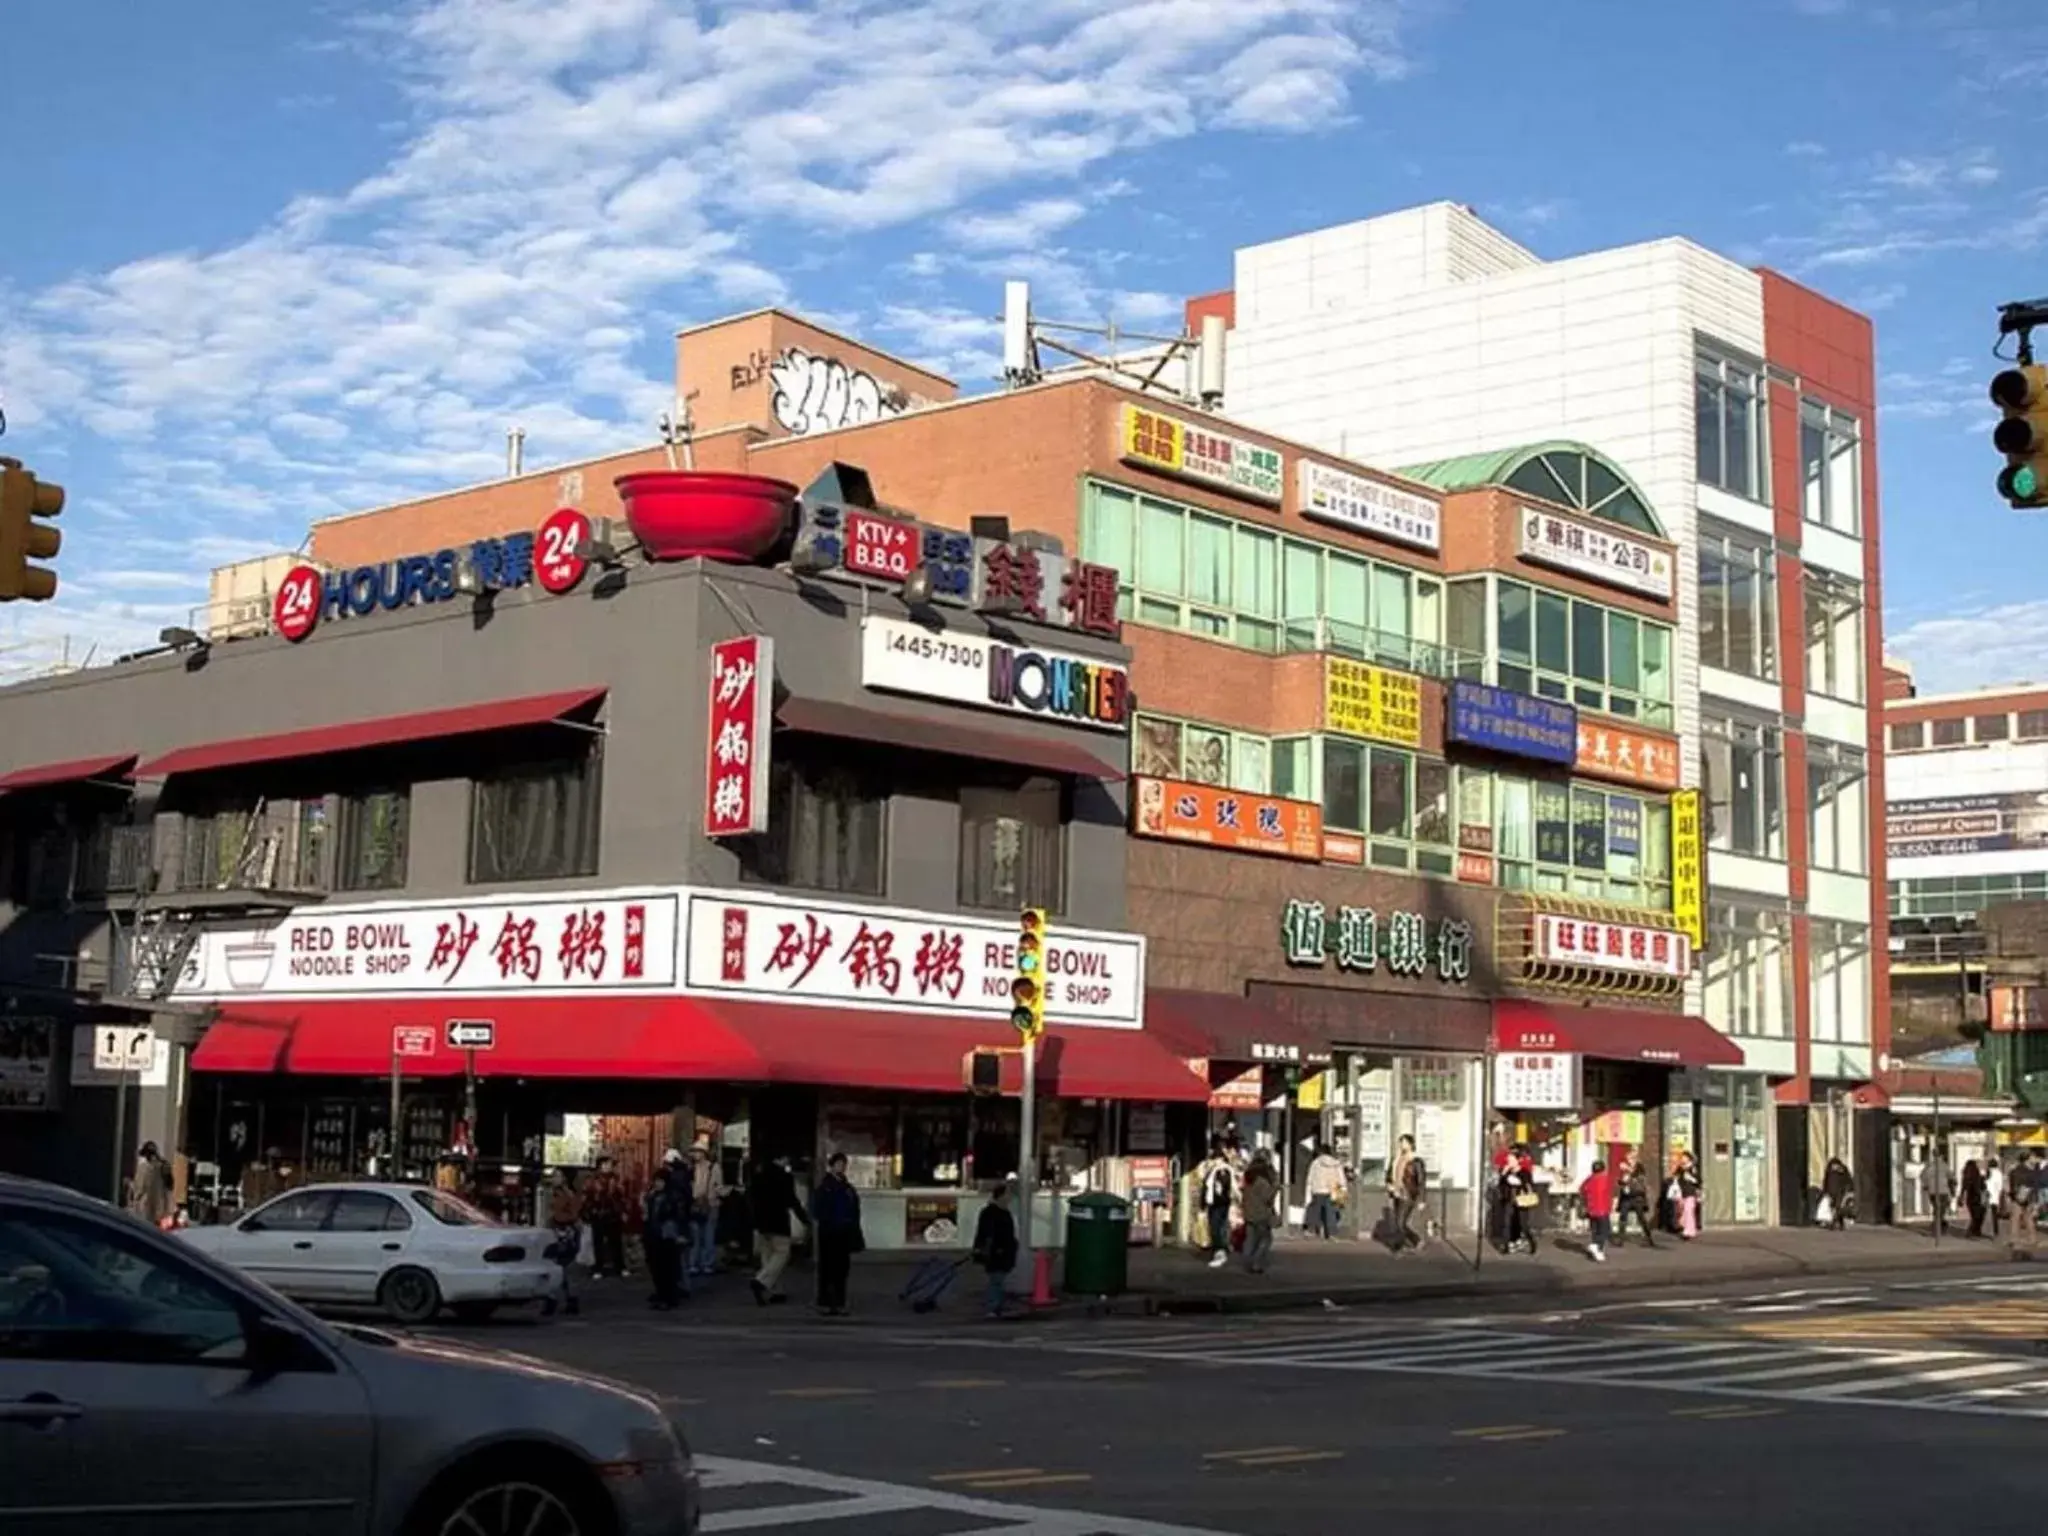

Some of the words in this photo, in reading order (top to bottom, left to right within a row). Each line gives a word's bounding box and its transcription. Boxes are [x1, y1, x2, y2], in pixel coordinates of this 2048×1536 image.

[542, 521, 580, 566] 24
[282, 576, 314, 615] 24
[321, 549, 458, 622] HOURS
[988, 644, 1128, 722] MONSTER
[290, 926, 334, 952] RED
[345, 923, 411, 949] BOWL
[289, 956, 353, 977] NOODLE
[365, 953, 411, 974] SHOP
[984, 941, 1022, 970] RE
[1046, 949, 1113, 979] BOWL
[1066, 983, 1112, 1005] SHOP
